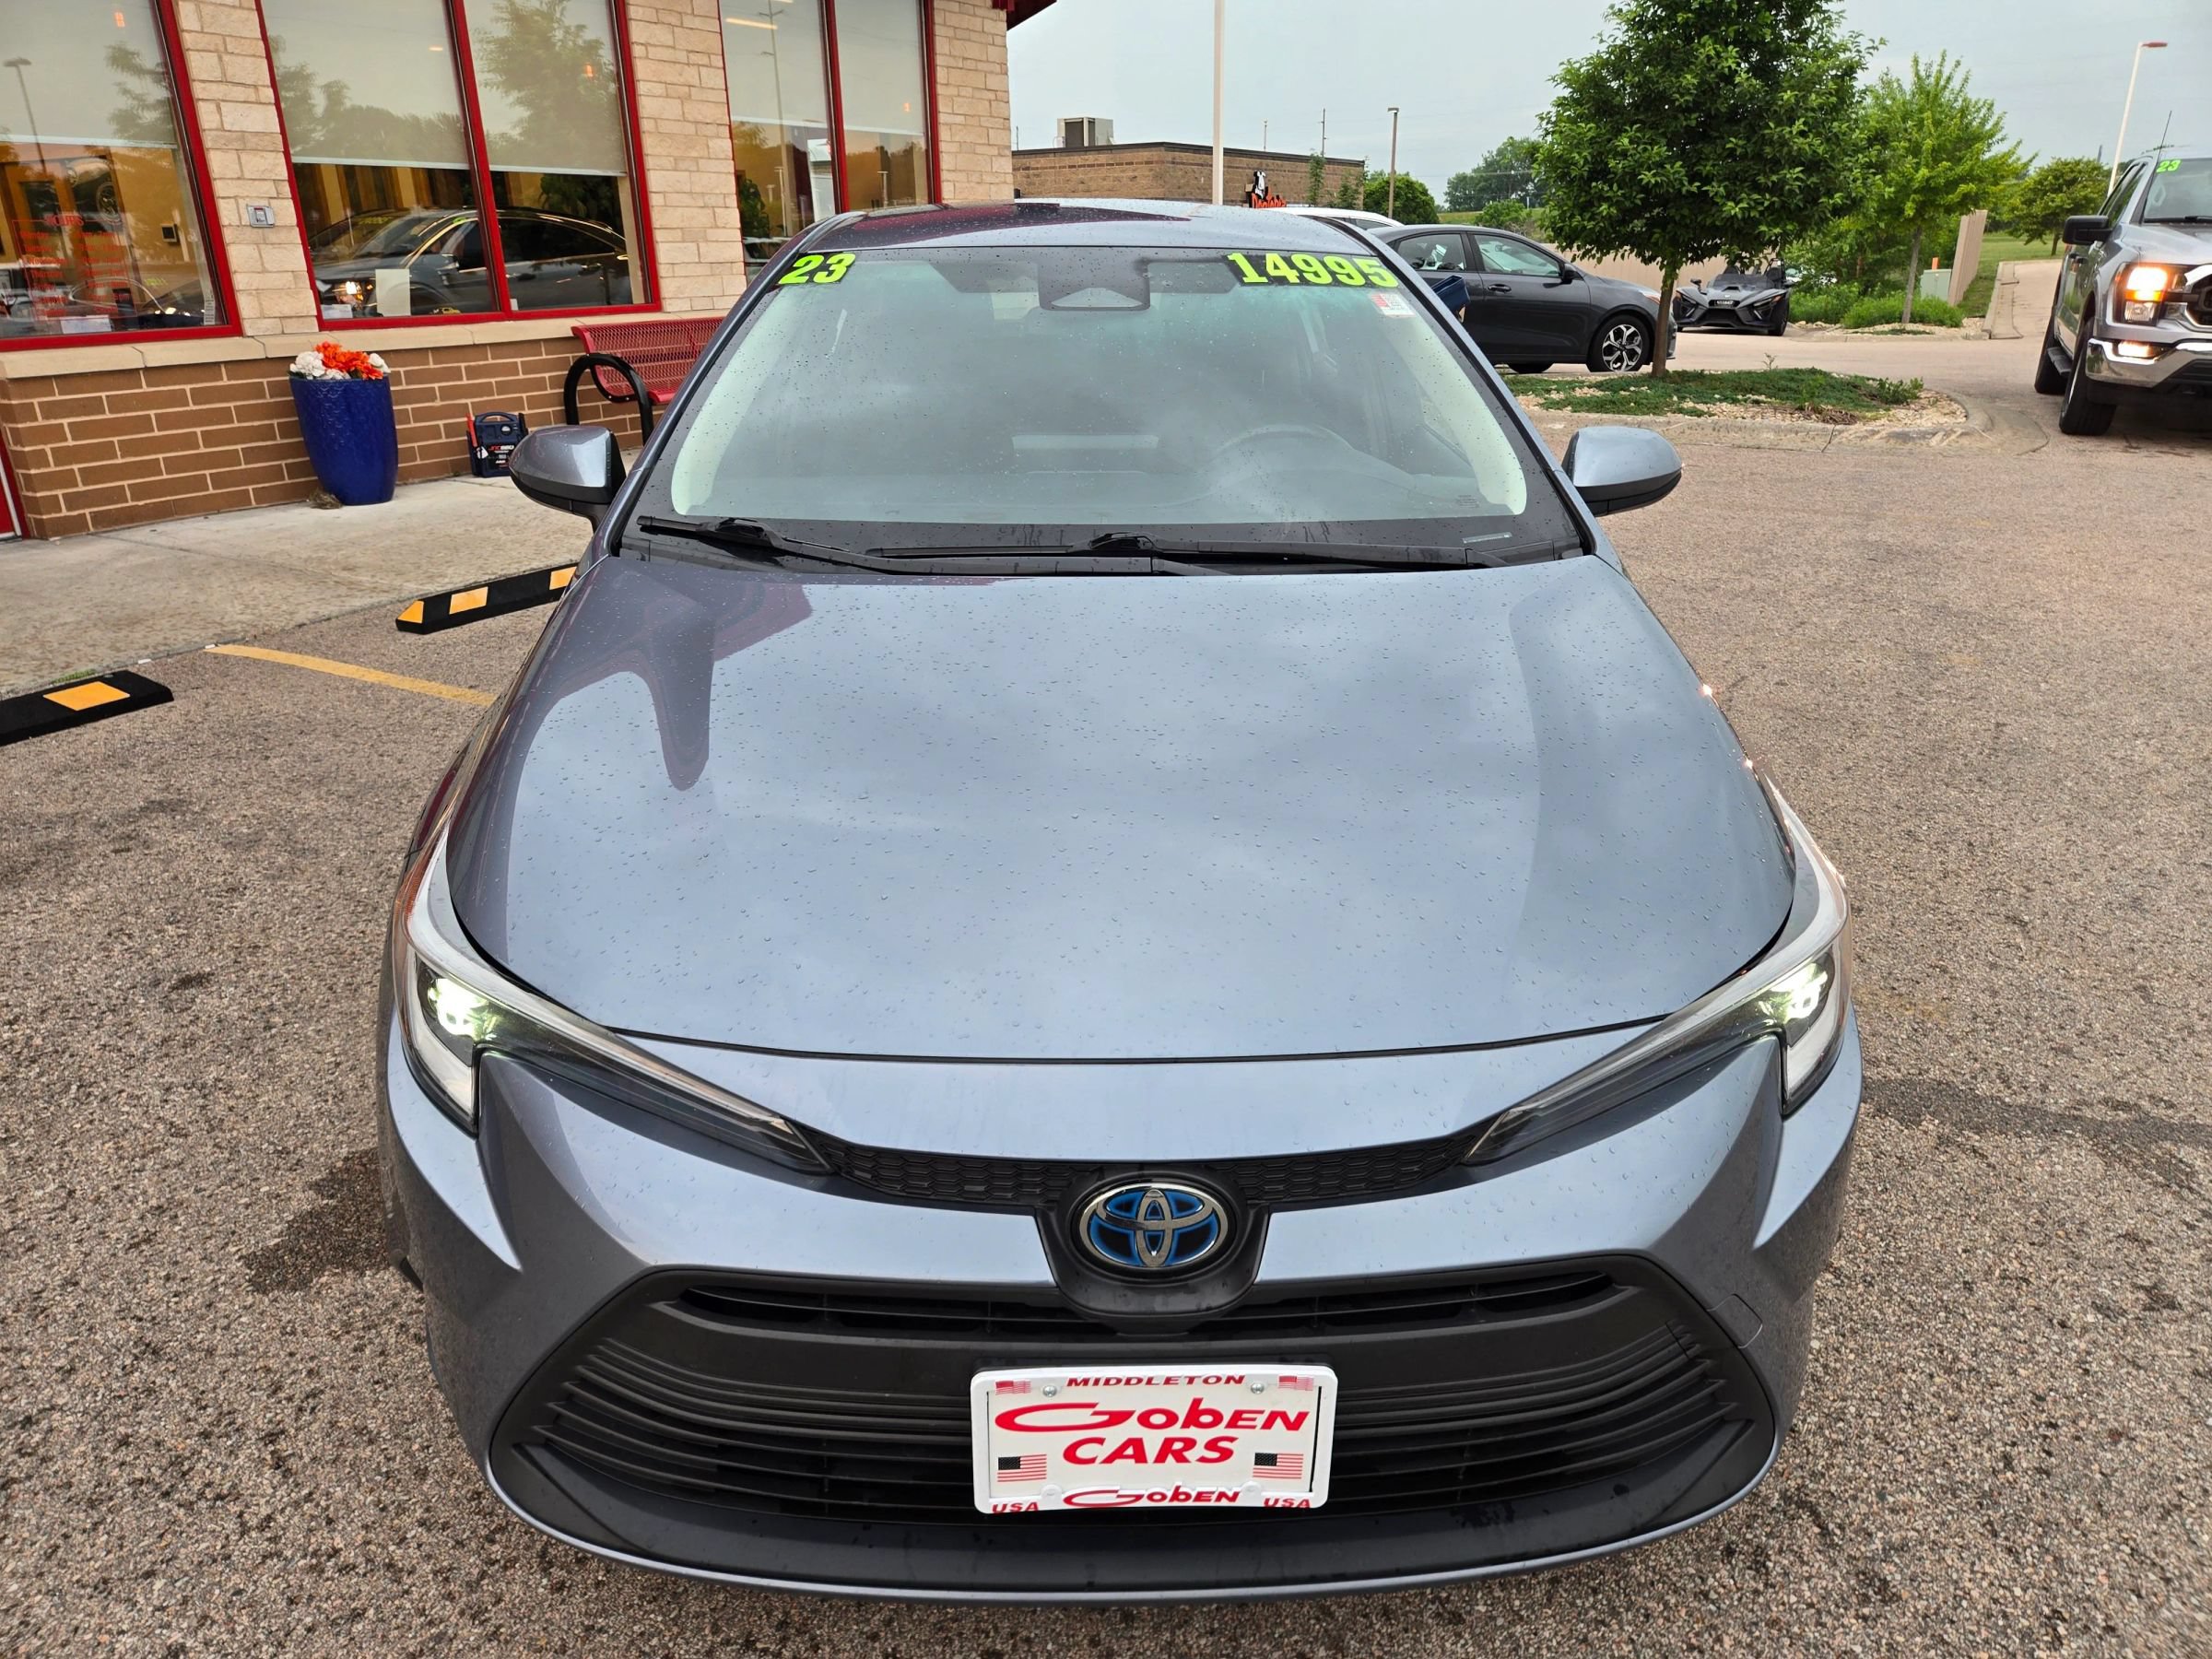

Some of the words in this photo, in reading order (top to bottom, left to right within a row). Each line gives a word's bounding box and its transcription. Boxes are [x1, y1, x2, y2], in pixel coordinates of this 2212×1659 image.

[2156, 159, 2182, 172] 23
[778, 253, 856, 285] 23
[1228, 253, 1399, 288] 14995
[1066, 1374, 1245, 1387] MIDDLETON
[1063, 1435, 1239, 1465] CARS
[991, 1500, 1040, 1514] USA
[1263, 1497, 1312, 1510] USA
